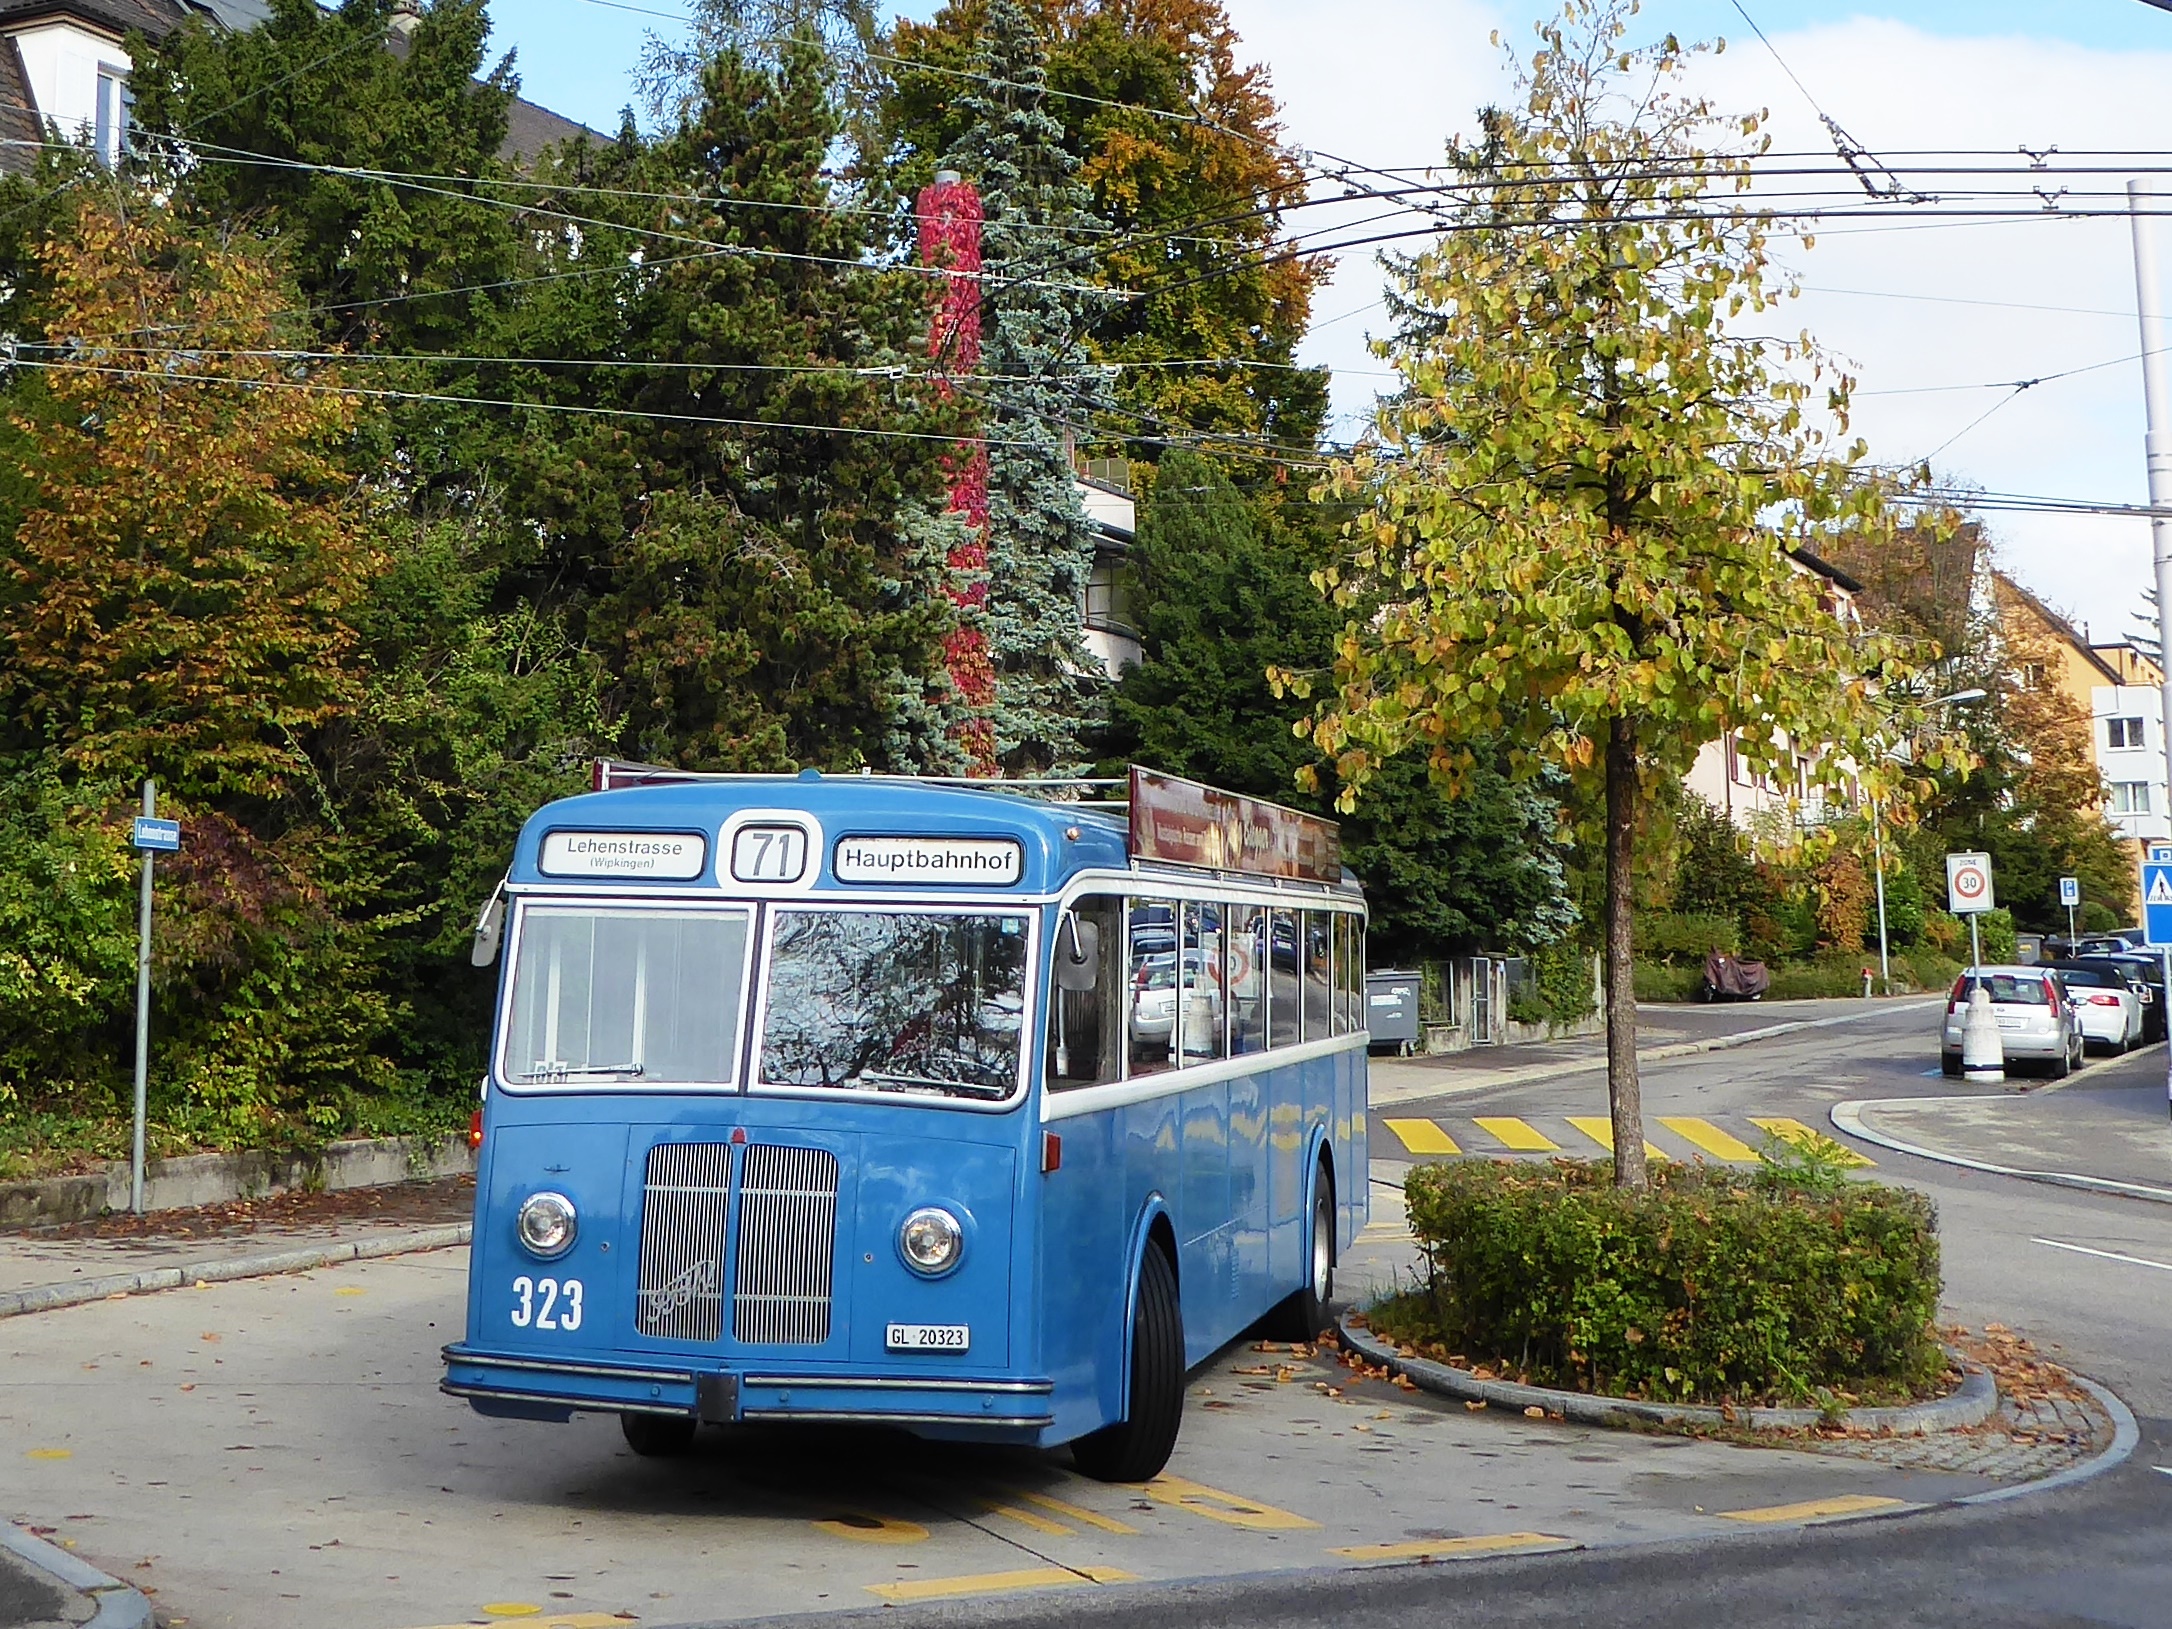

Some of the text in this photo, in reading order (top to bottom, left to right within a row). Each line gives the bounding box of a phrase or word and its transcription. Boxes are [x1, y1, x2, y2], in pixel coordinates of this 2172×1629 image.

[567, 837, 683, 856] Lehenstrasse
[753, 833, 790, 877] 71
[589, 856, 656, 870] (Wipkingen)
[846, 848, 1013, 872] Hauptbahnhof
[1962, 877, 1977, 889] 30
[511, 1276, 583, 1331] 323
[891, 1328, 964, 1346] GL 20323
